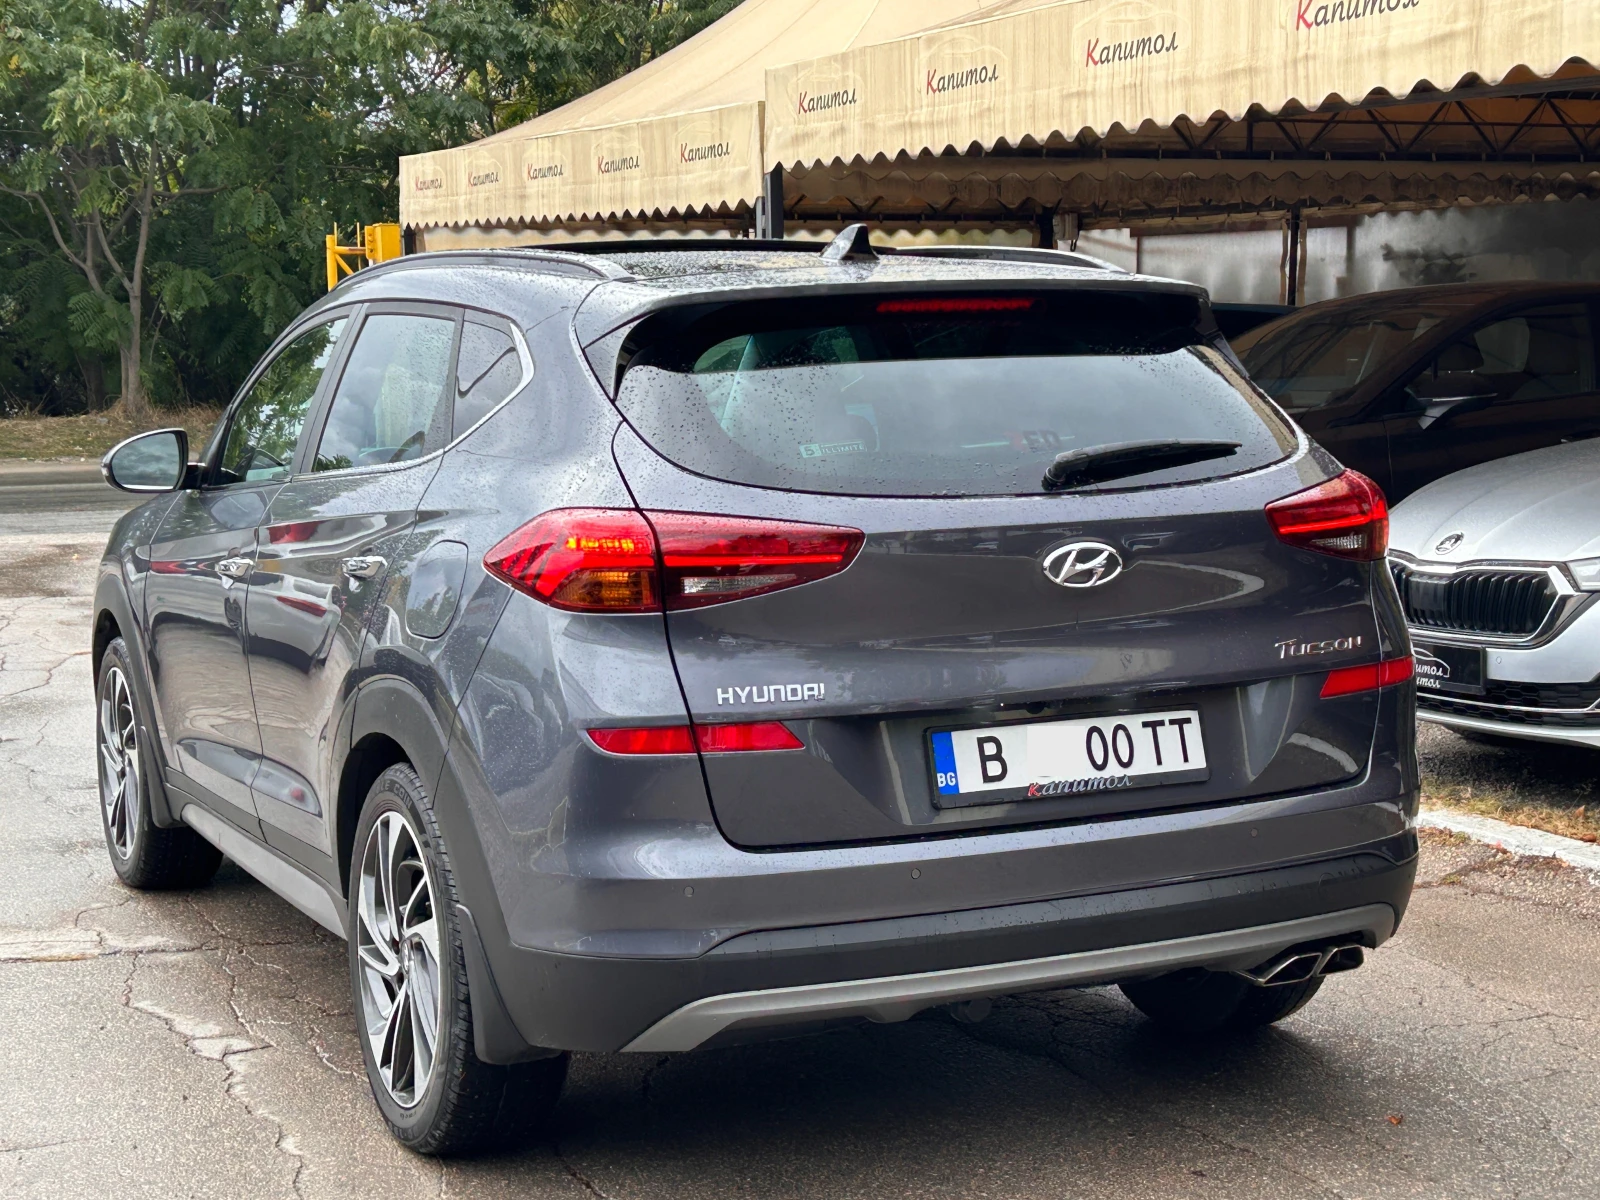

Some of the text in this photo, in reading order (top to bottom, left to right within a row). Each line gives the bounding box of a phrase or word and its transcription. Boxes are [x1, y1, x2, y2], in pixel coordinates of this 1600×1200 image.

[1086, 32, 1179, 67] Капитол
[926, 64, 998, 96] Капитол
[798, 88, 857, 115] Капитол
[680, 142, 730, 163] Капитол
[527, 163, 564, 181] Капитол
[597, 155, 640, 174] Капитол
[415, 176, 443, 191] Капитол
[467, 171, 499, 187] Капитол
[716, 683, 826, 705] HYUNDAI
[977, 736, 1008, 783] B
[936, 772, 956, 787] BG
